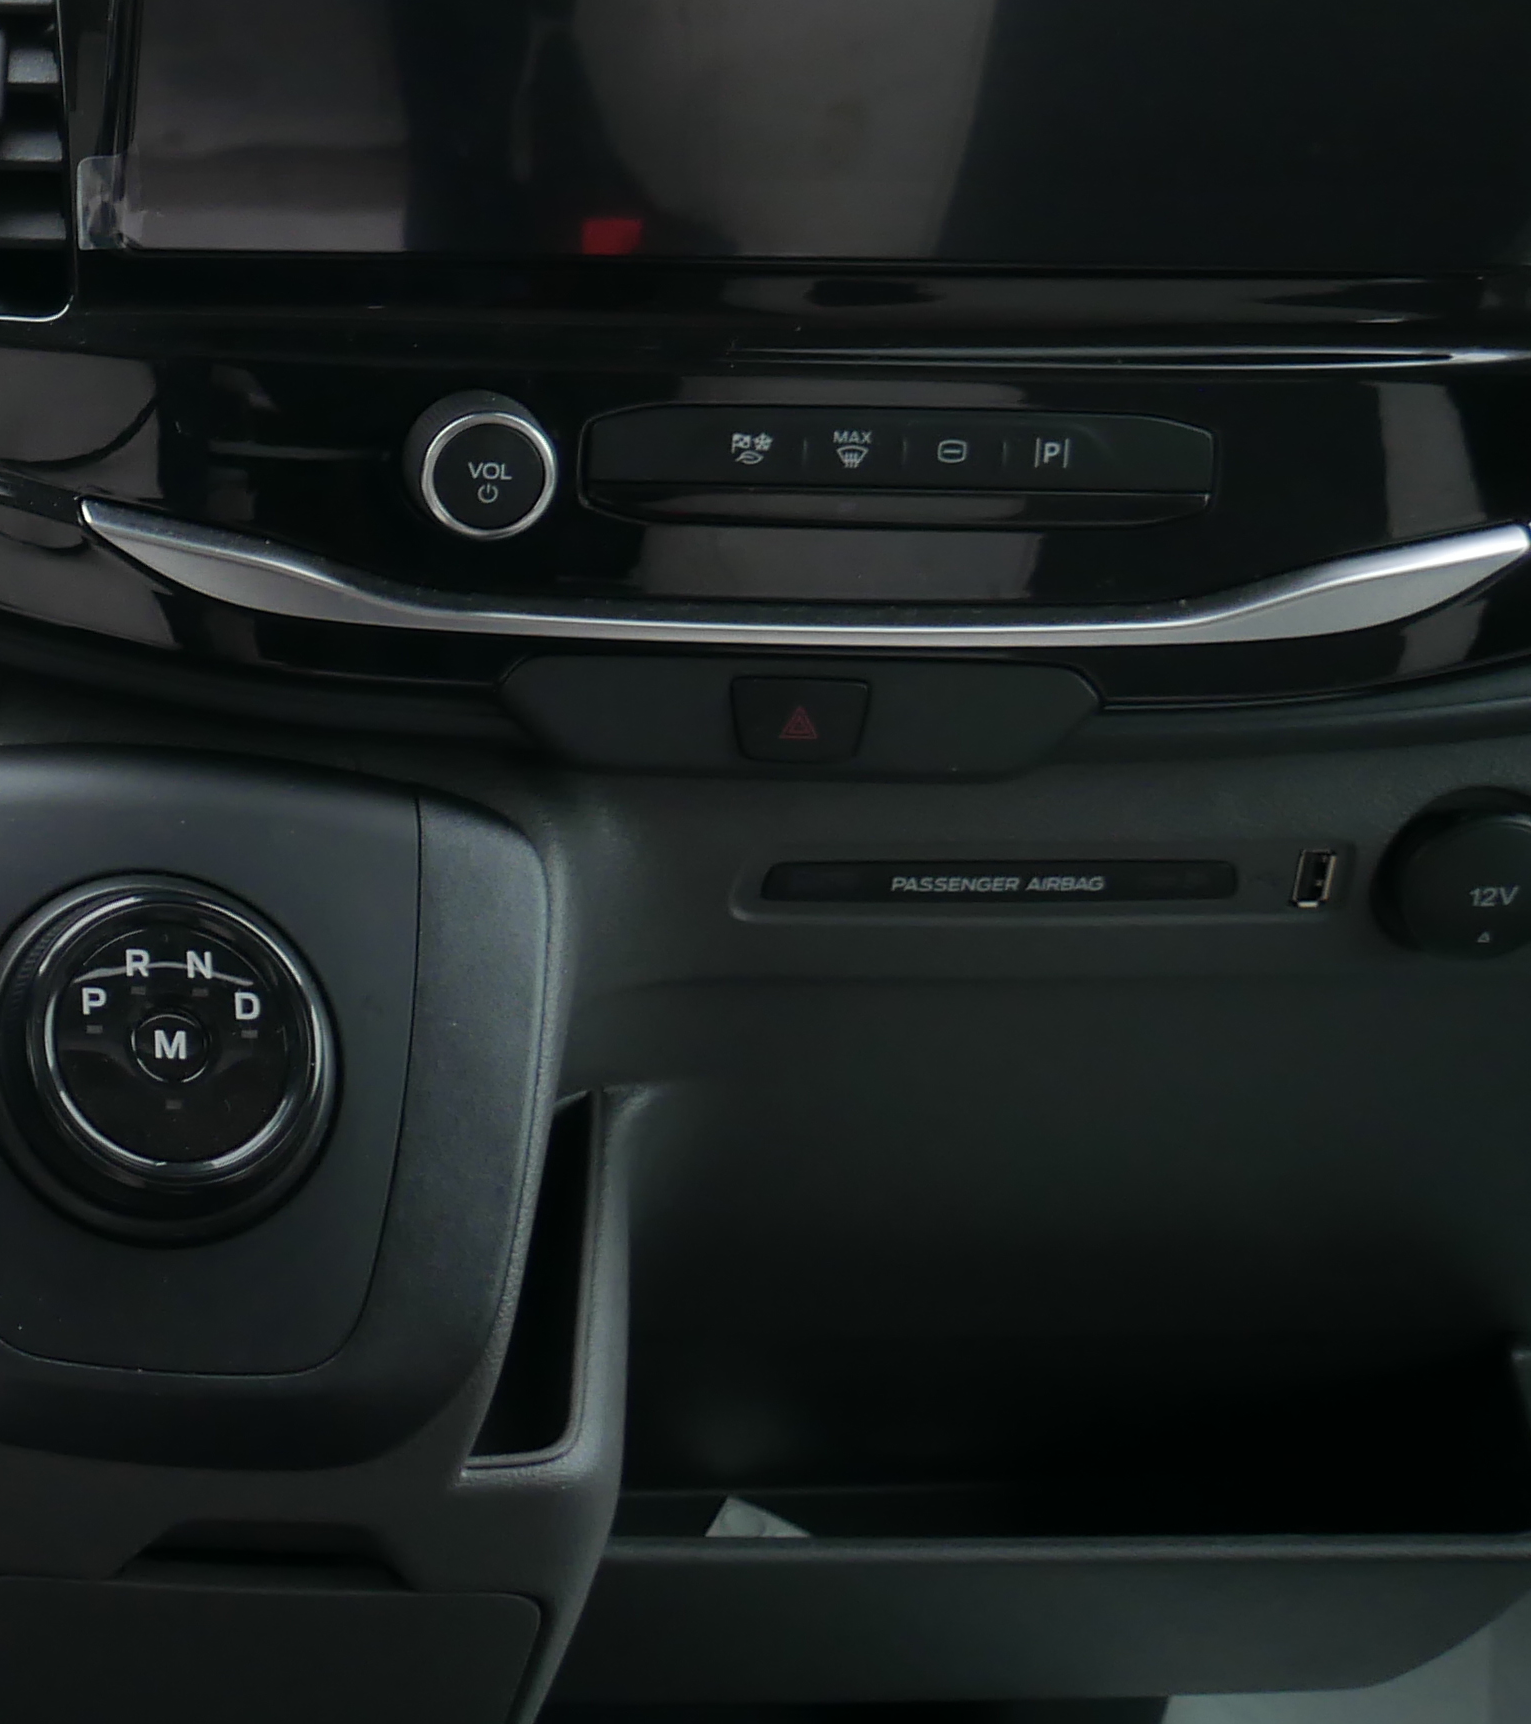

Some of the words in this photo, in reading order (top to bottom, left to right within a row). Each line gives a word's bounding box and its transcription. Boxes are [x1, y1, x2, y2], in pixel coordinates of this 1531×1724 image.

[832, 430, 872, 444] MAX
[468, 461, 512, 480] VOL
[891, 876, 1020, 892] PASSENGER
[1025, 876, 1106, 892] AIRBAG
[1469, 884, 1520, 907] 12V
[125, 948, 150, 977] R
[186, 950, 213, 979] N
[81, 987, 107, 1015] P
[234, 992, 261, 1020] D
[154, 1029, 187, 1060] M
